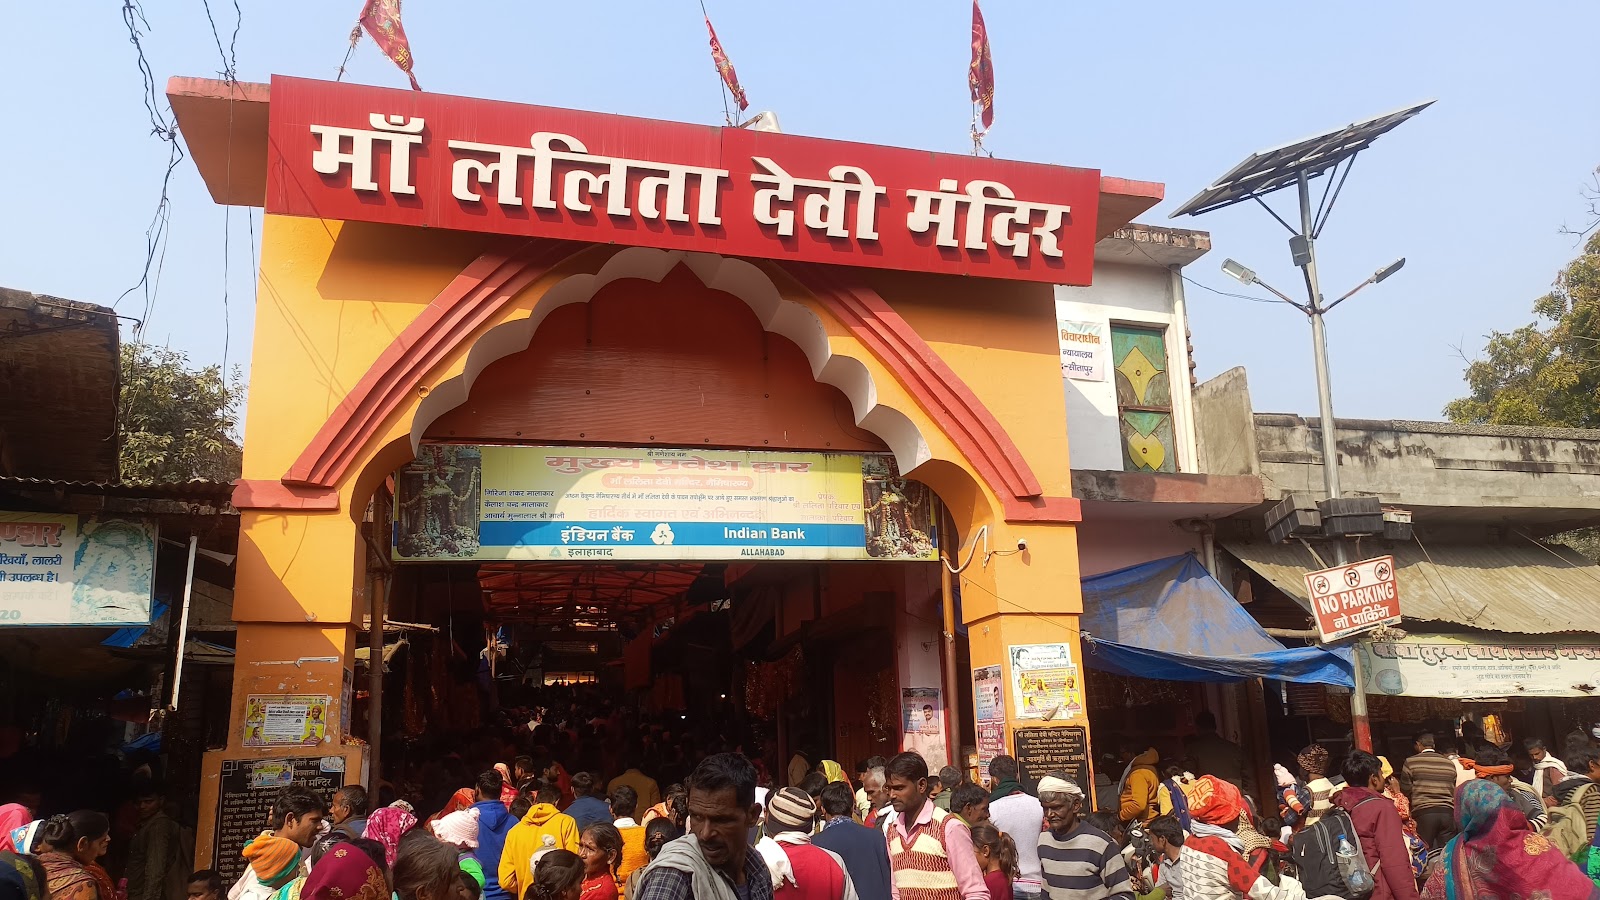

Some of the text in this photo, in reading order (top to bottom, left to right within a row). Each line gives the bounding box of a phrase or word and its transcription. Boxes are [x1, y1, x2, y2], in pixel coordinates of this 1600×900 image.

[448, 131, 728, 227] ललिता
[750, 156, 888, 241] देवी
[905, 178, 1071, 259] मंदिर
[1061, 328, 1100, 344] विचाराधीन
[1062, 349, 1093, 359] न्यायालय
[1061, 362, 1093, 376] -सीतापुर
[545, 455, 812, 474] मुख्य प्रवेश द्वार
[623, 477, 654, 486] ललिता
[656, 477, 672, 486] देवी
[509, 489, 524, 497] शंकर
[802, 500, 825, 509] ललिता
[484, 511, 506, 519] आचार्य
[588, 505, 629, 519] हार्दिक
[634, 509, 677, 519] स्वागत
[681, 506, 701, 519] एवं
[832, 513, 854, 521] परिवार
[0, 522, 66, 547] ण्डार
[561, 525, 635, 543] इंडियन बैंक
[724, 527, 806, 539] Indian Bank
[567, 548, 613, 557] इलाहाबाद
[741, 548, 785, 556] ALLAHABAD
[32, 554, 63, 565] लालरी
[9, 572, 44, 582] उपलब्ध
[1318, 582, 1395, 615] NO PARKING
[1333, 613, 1350, 629] नो
[1350, 604, 1390, 625] पार्किंग
[1506, 643, 1558, 661] प्रसाद
[308, 776, 332, 787] मन्दिर
